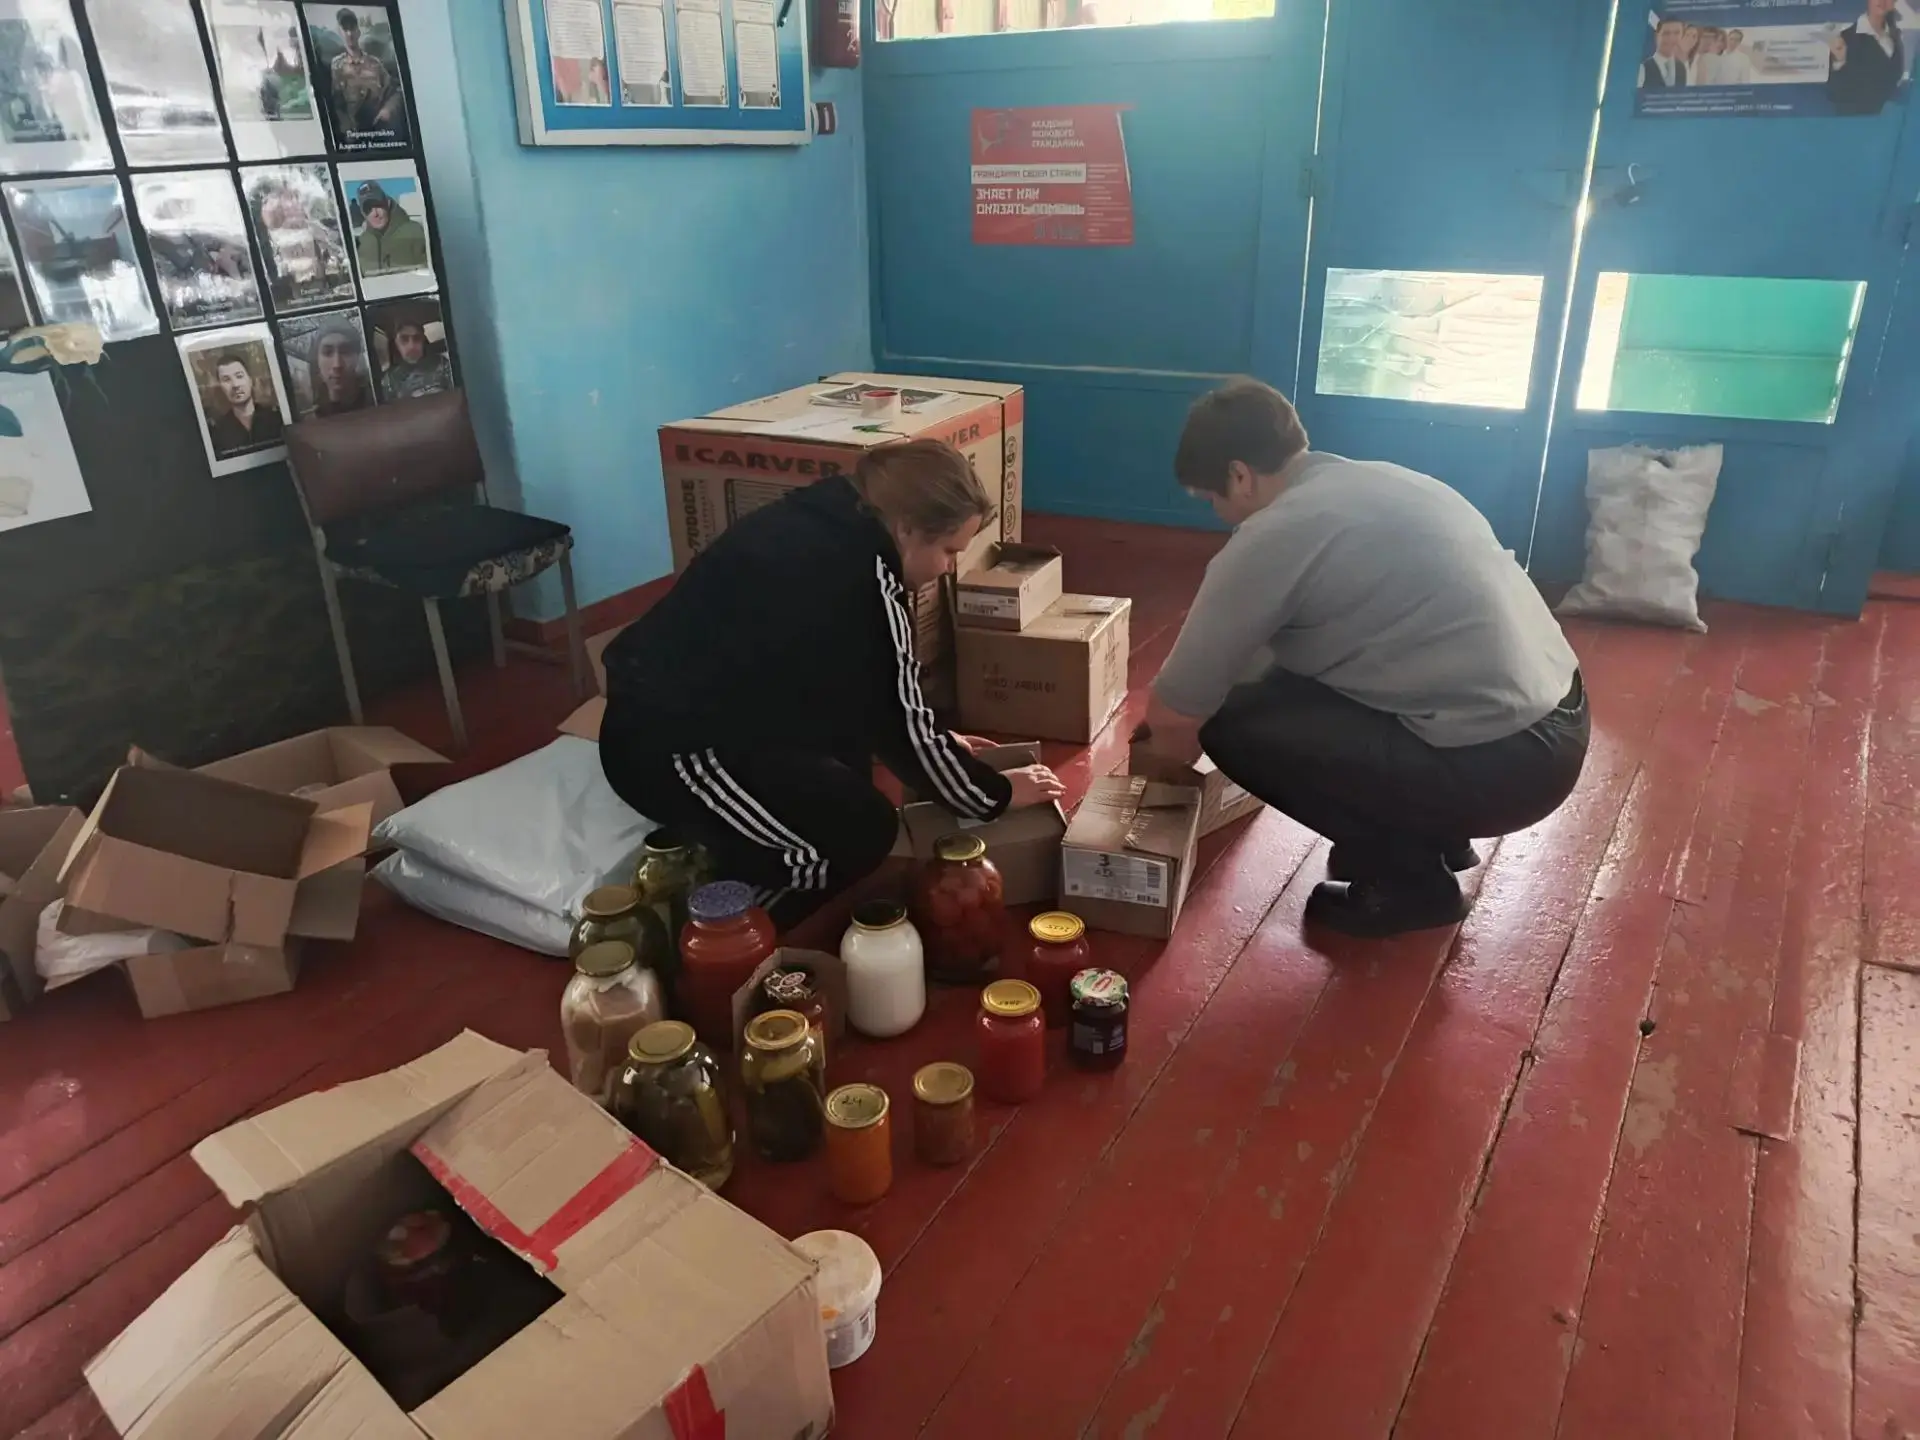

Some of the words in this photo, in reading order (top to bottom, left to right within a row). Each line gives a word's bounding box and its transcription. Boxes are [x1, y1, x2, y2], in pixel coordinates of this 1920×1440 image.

[976, 188, 1014, 200] ЗНАЕТ
[1016, 187, 1040, 200] КАК
[976, 203, 1029, 215] ОКАЗАТЬ
[945, 423, 980, 445] VER
